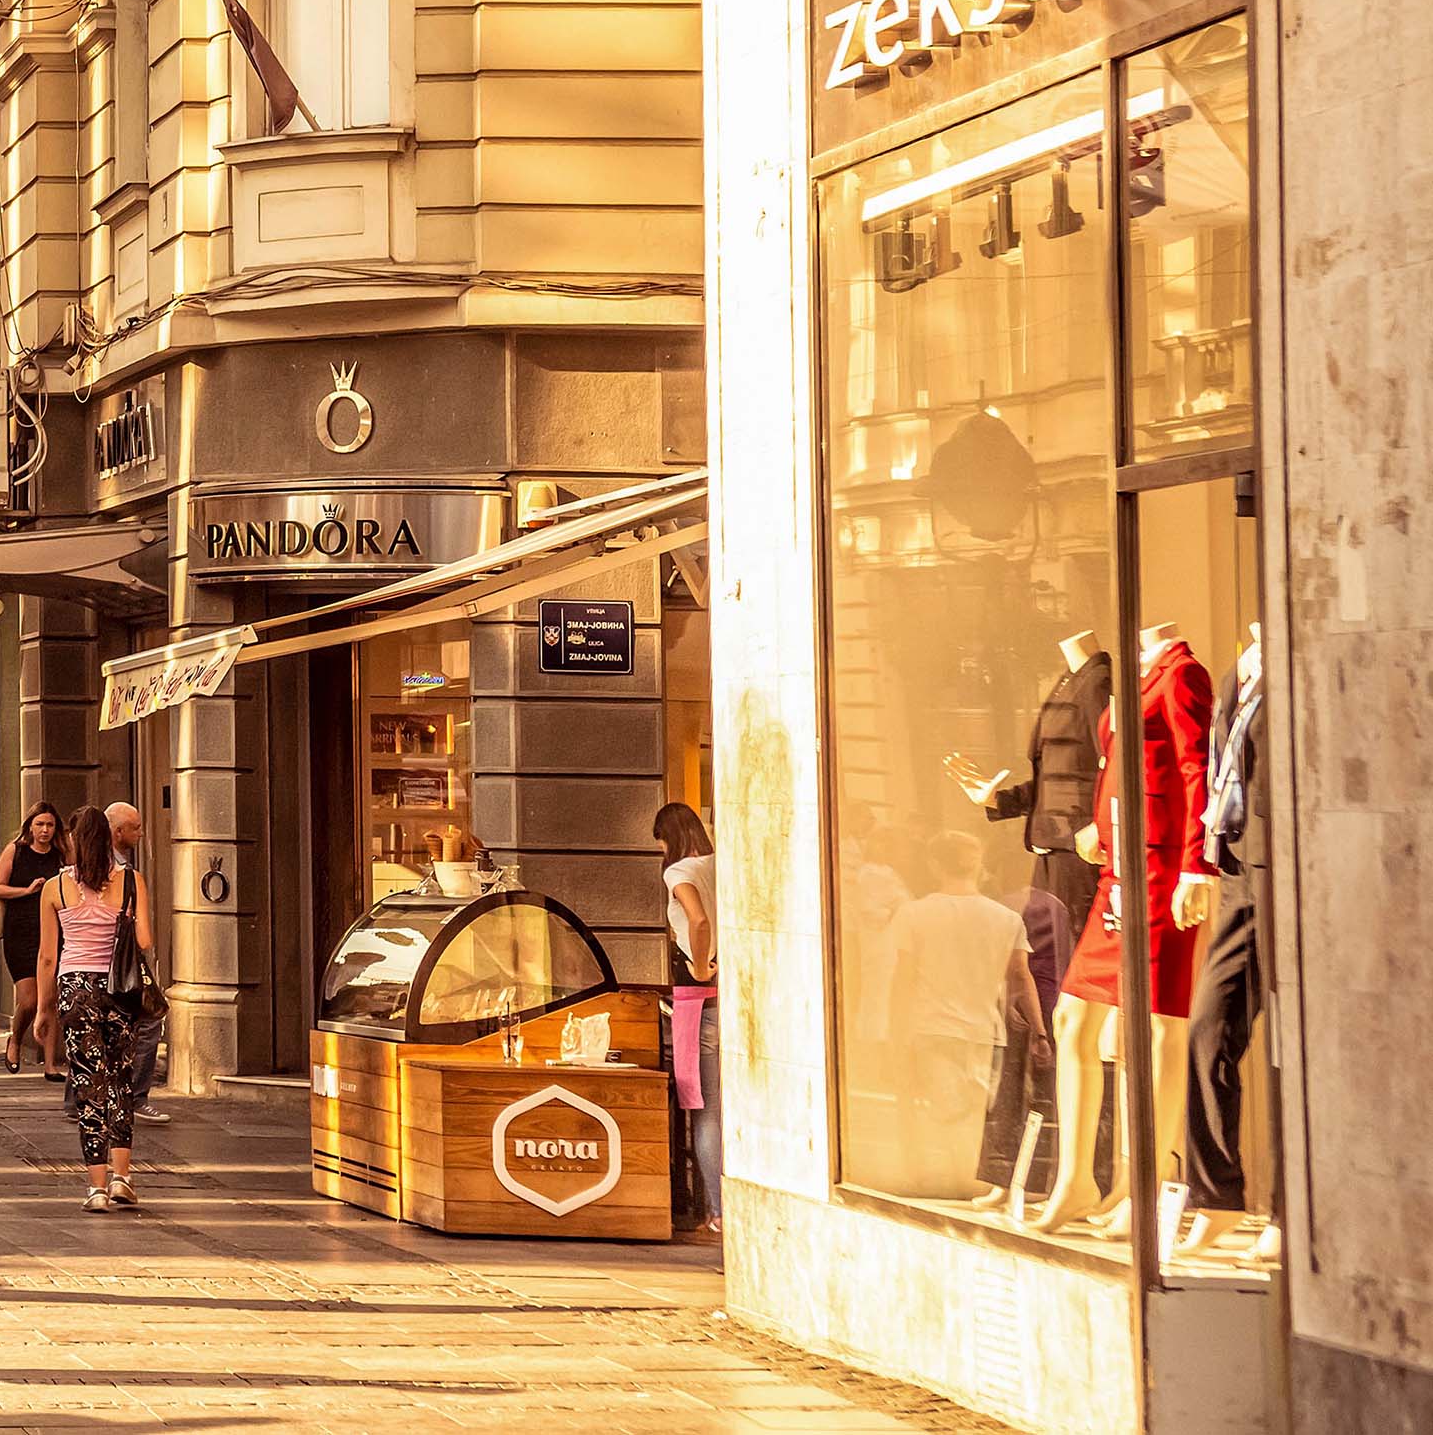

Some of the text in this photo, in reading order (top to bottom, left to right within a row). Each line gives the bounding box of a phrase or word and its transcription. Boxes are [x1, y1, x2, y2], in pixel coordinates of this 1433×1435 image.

[206, 517, 422, 559] PANDORA
[568, 652, 623, 662] ZMAJ-JOVINA
[514, 1138, 600, 1160] nora
[530, 1164, 584, 1172] GELATO
